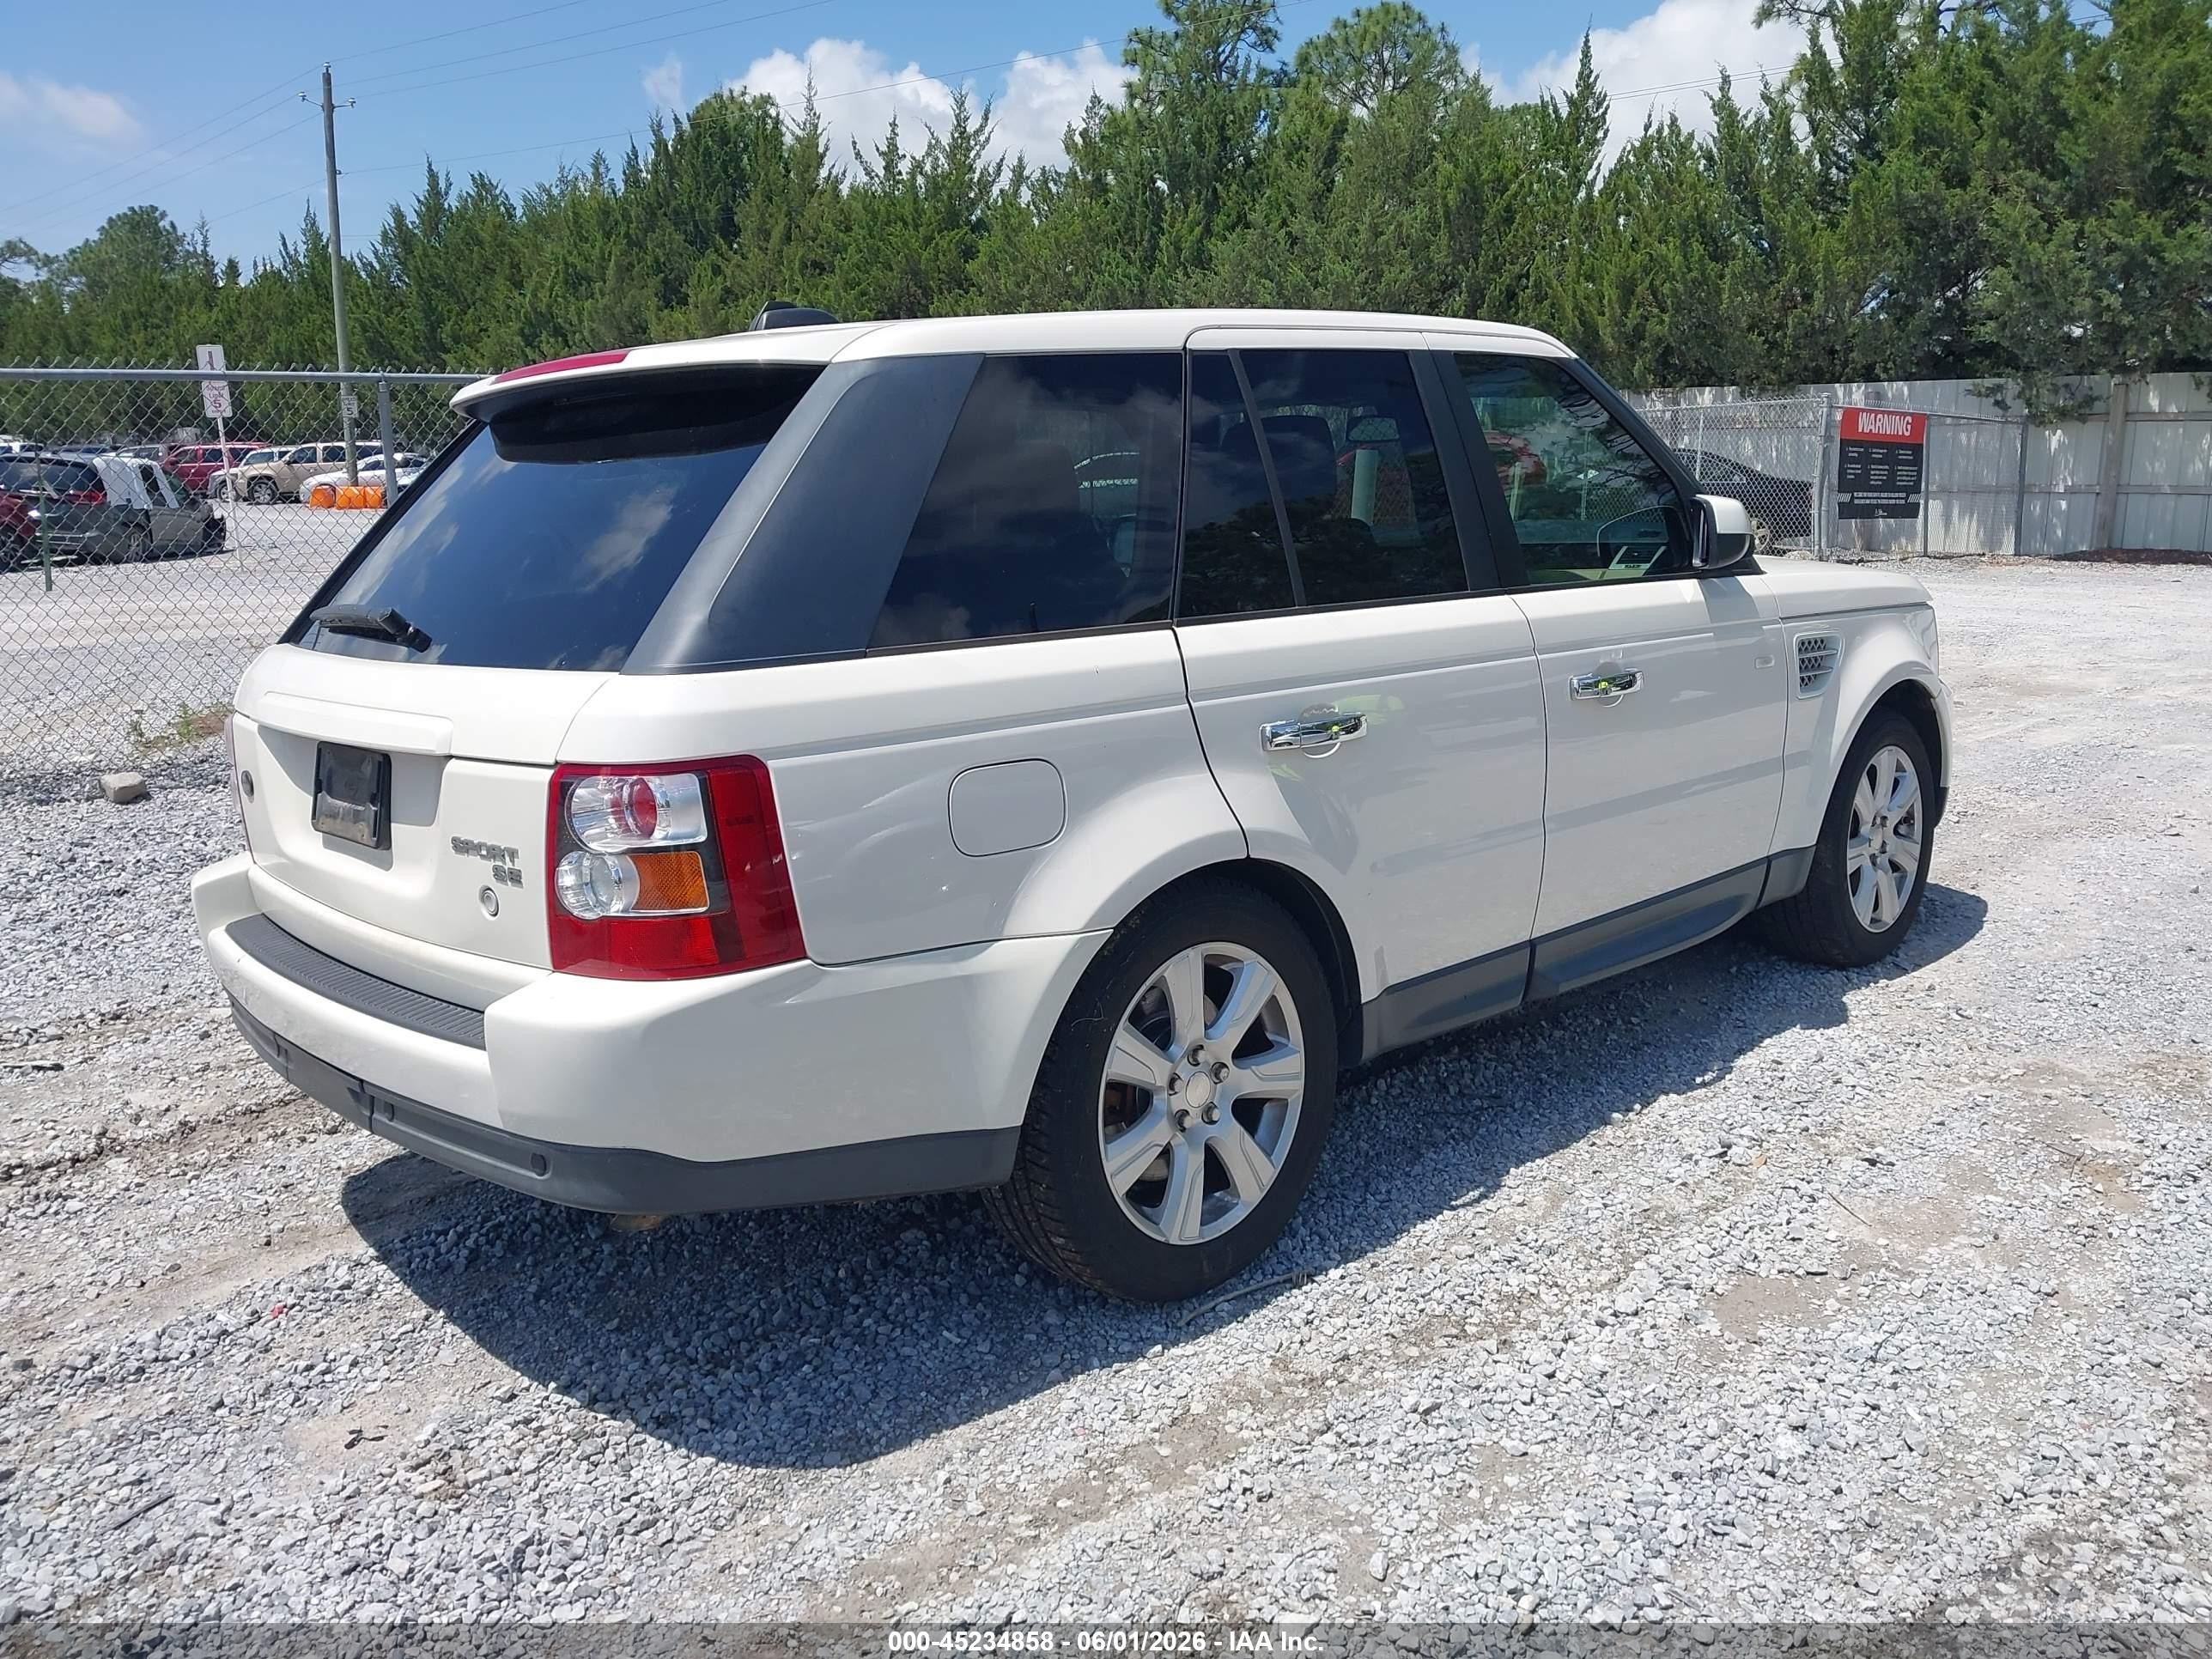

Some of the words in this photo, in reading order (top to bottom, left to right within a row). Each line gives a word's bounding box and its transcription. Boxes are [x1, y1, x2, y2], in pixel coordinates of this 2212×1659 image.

[213, 399, 222, 408] 5
[346, 407, 354, 416] 5
[1858, 411, 1912, 436] WARNING
[451, 836, 520, 867] SPORT
